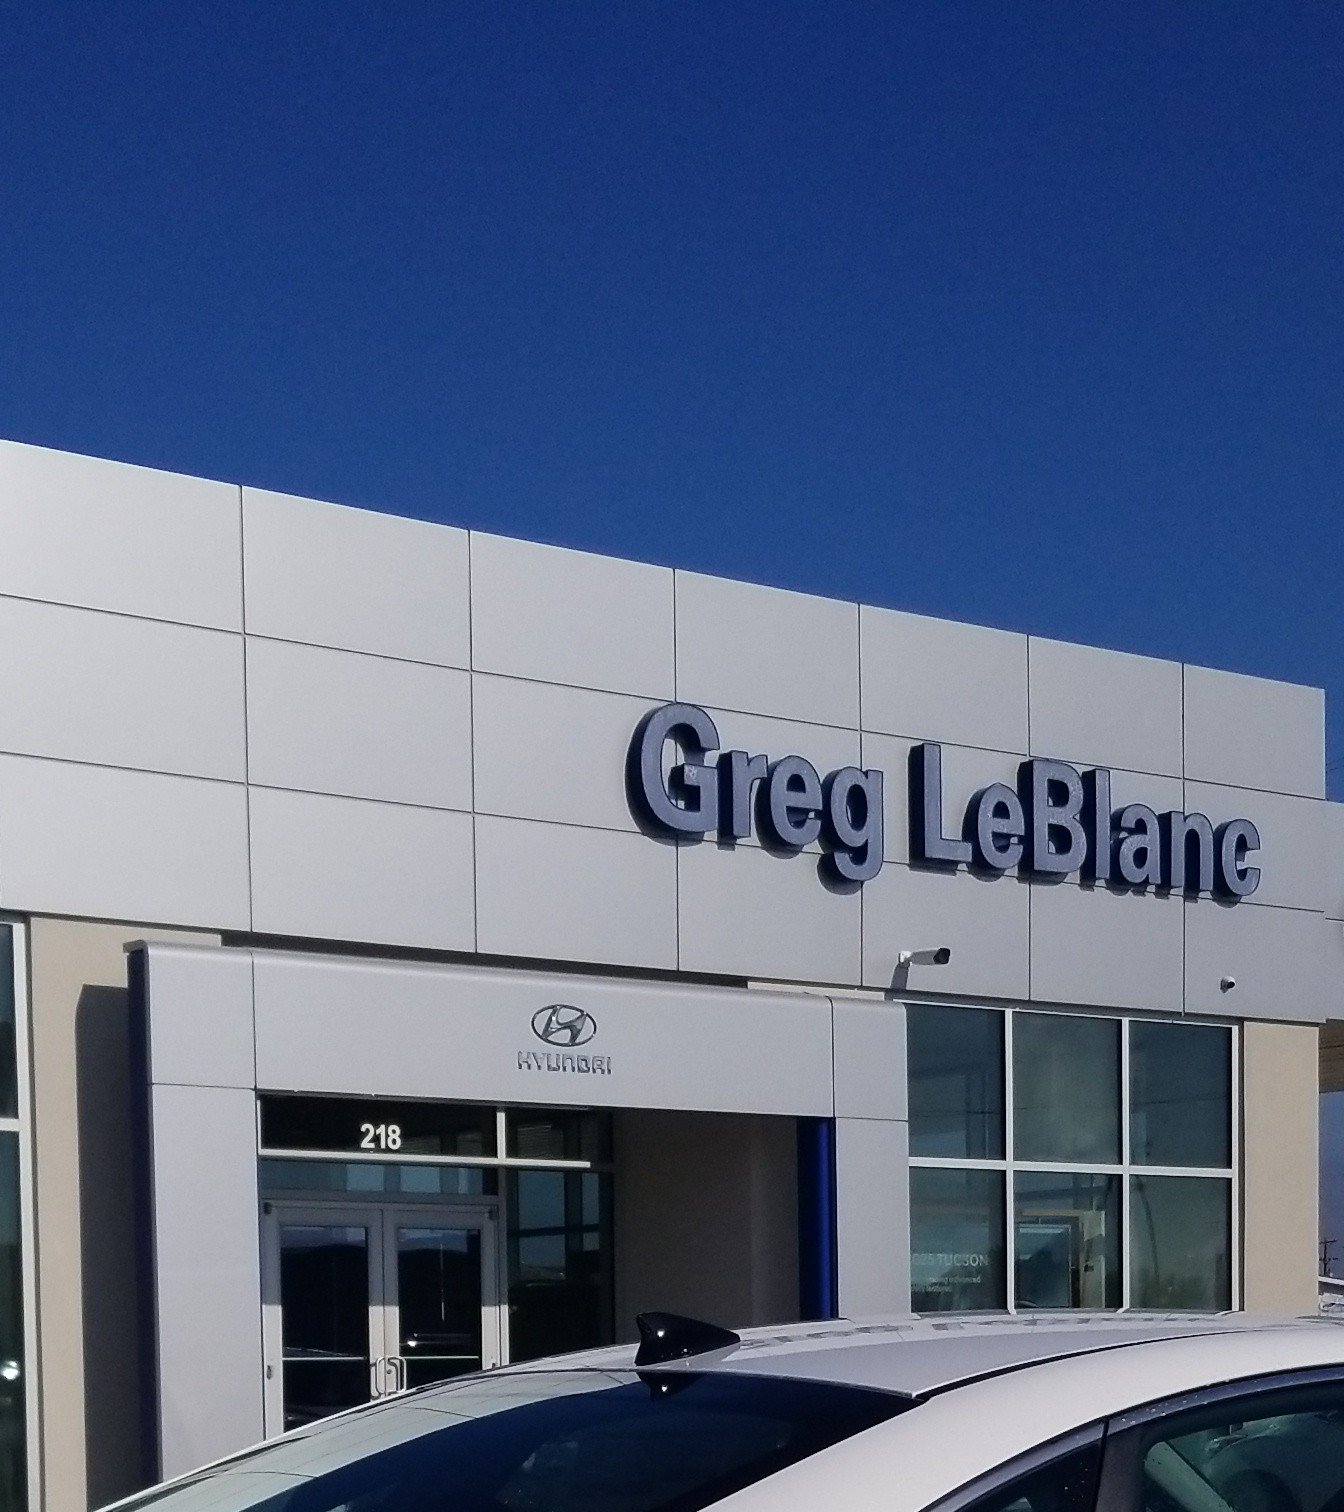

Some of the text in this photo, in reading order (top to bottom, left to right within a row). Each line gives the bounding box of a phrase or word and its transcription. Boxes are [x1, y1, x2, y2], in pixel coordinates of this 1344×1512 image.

[626, 701, 1262, 900] Greg LeBlanc
[517, 1050, 612, 1075] HYUNDAI
[360, 1123, 402, 1151] 218
[937, 1253, 989, 1267] TUCSON
